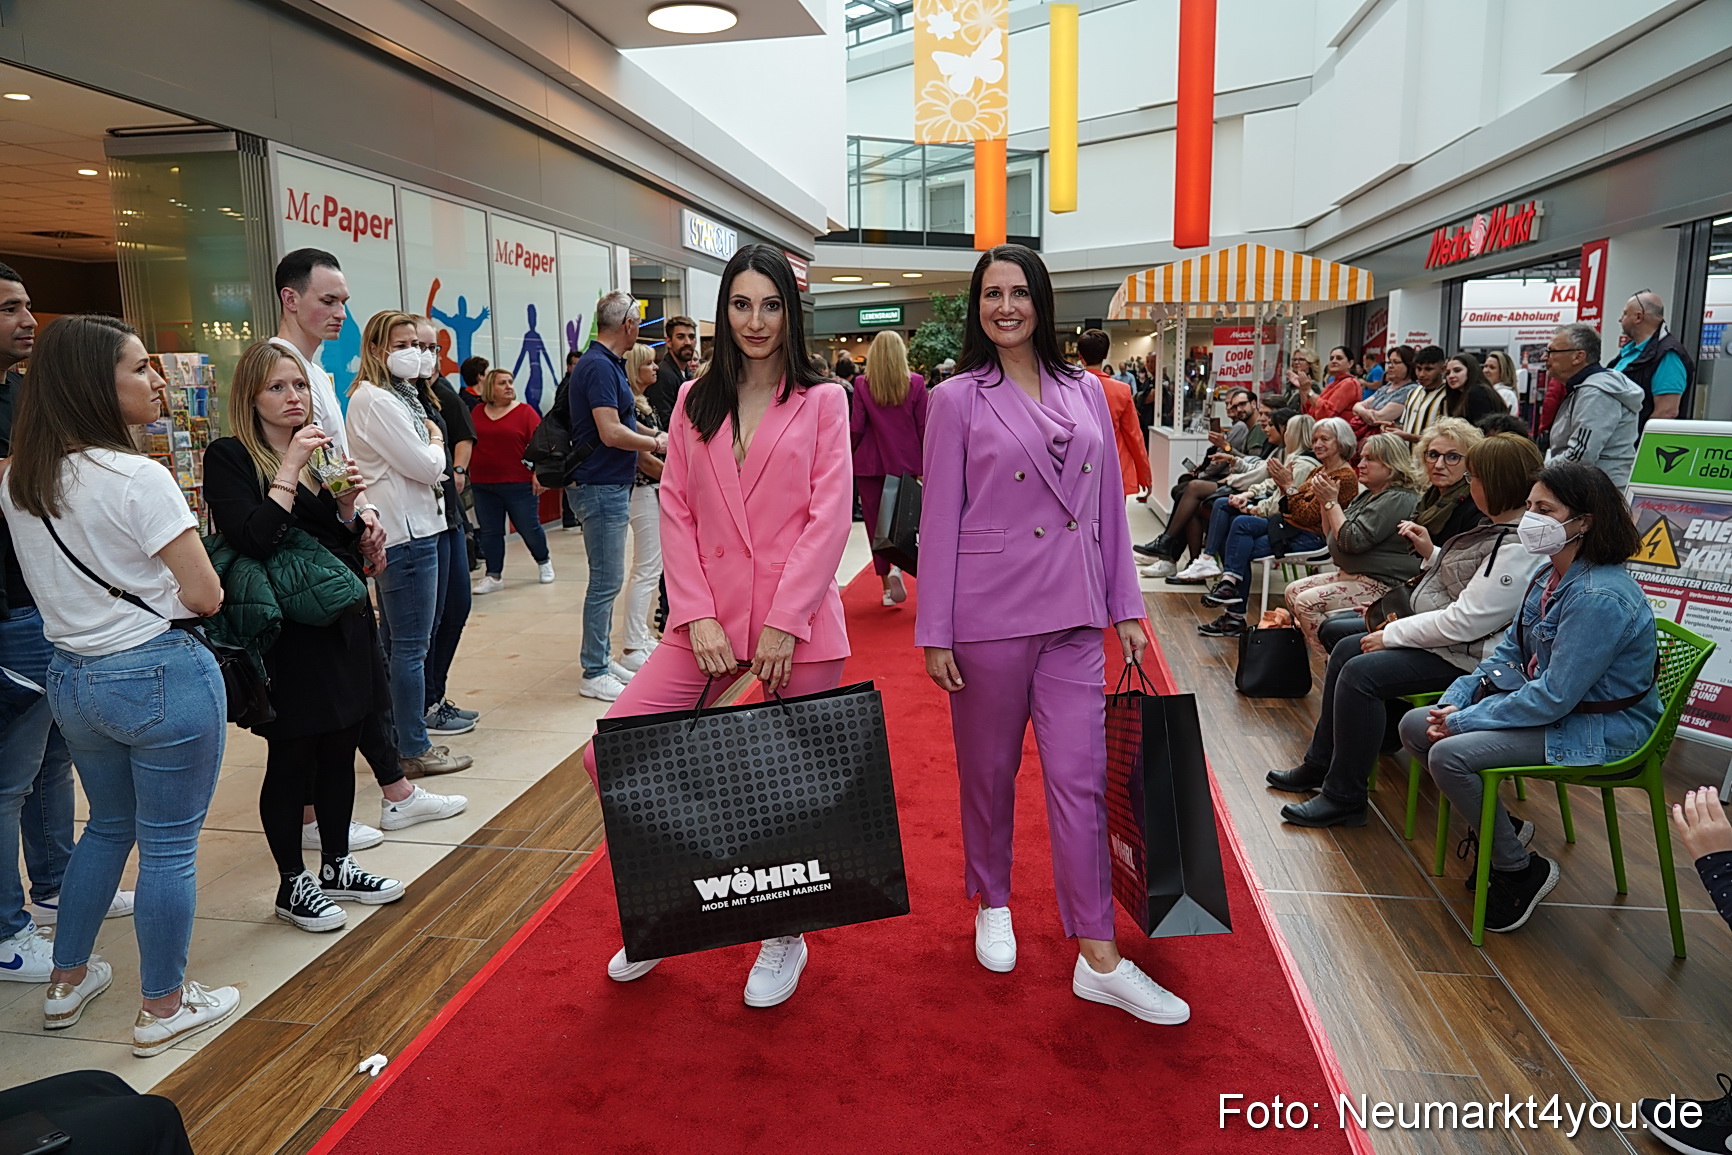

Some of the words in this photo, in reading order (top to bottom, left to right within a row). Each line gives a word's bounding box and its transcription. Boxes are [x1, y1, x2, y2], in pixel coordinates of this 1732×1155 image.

[285, 187, 394, 243] McPaper
[495, 239, 555, 277] McPaper
[1550, 285, 1577, 303] KA
[1469, 311, 1561, 323] Online-Abholung
[1225, 348, 1254, 363] Coole
[1683, 518, 1732, 544] ENE
[1630, 571, 1701, 589] STROMANBIETER
[1688, 605, 1722, 615] Günstigster
[1698, 691, 1717, 702] UND
[1691, 716, 1712, 728] 150€
[693, 859, 831, 901] WÖHRL
[702, 901, 729, 912] MODE
[731, 897, 748, 906] MIT
[750, 890, 790, 904] STARKEN
[792, 882, 832, 896] MARKEN
